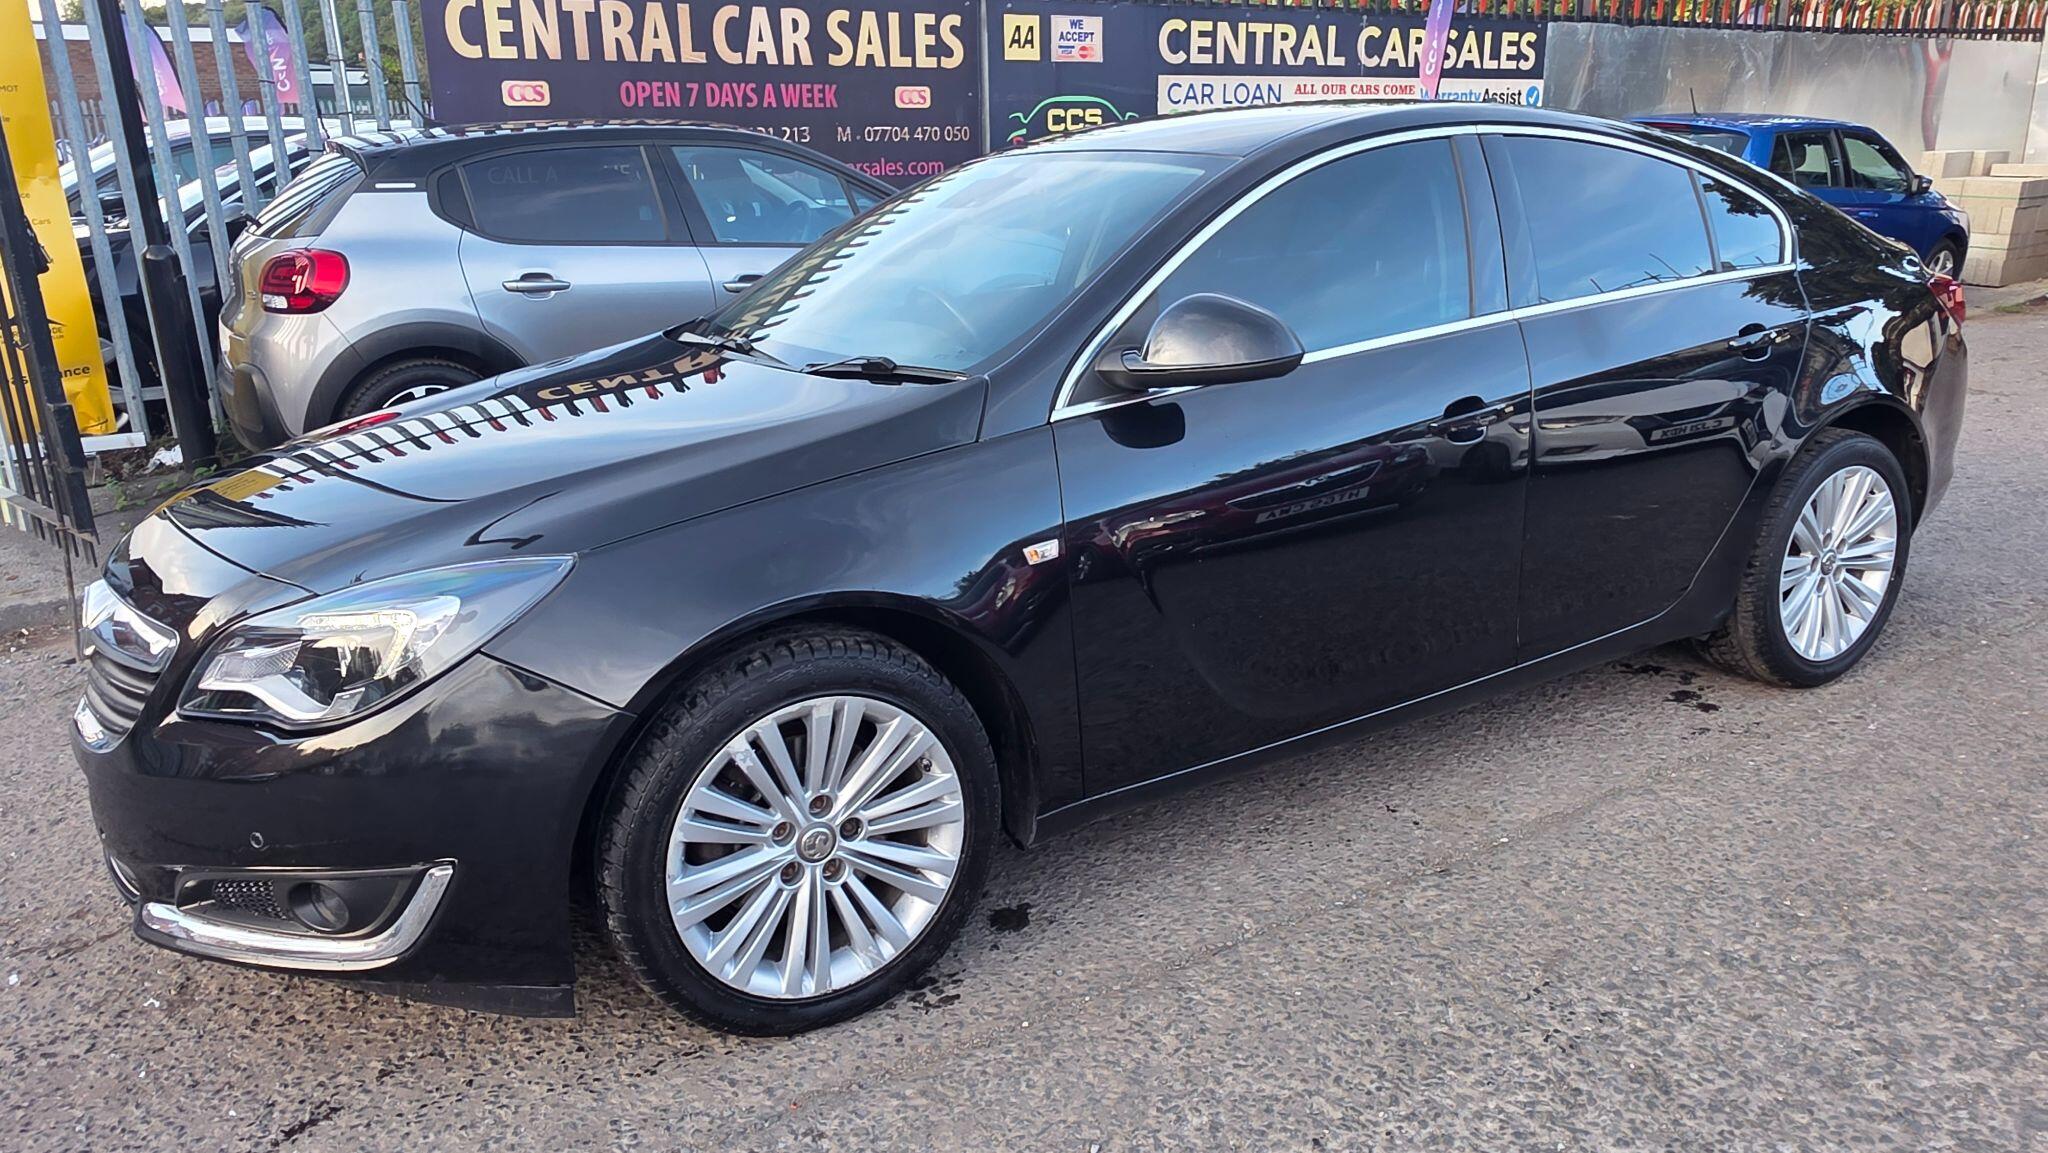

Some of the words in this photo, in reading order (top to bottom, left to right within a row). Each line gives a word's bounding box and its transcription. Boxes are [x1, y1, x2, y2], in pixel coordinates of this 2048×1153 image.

[1069, 19, 1084, 30] WE
[444, 0, 708, 63] CENTRAL
[712, 4, 814, 66] CAR
[826, 9, 965, 69] SALES
[1008, 25, 1035, 49] AA
[1058, 31, 1095, 43] ACCEPT
[1158, 18, 1346, 67] CENTRAL
[1356, 25, 1425, 68] CAR
[1443, 29, 1538, 71] SALES
[507, 84, 545, 103] CCS
[619, 81, 681, 108] OPEN
[686, 82, 699, 108] 7
[705, 82, 758, 108] DAYS
[763, 83, 777, 108] A
[780, 83, 838, 109] WEEK
[898, 89, 927, 105] CCS
[1167, 82, 1215, 105] CAR
[1223, 82, 1282, 105] LOAN
[1294, 84, 1317, 95] ALL
[1321, 84, 1347, 95] OUR
[1350, 84, 1380, 95] CARS
[1383, 84, 1416, 95] COME
[1047, 108, 1103, 132] CCS
[781, 126, 811, 142] 213
[837, 127, 852, 142] M
[864, 127, 910, 142] 07704
[914, 127, 940, 142] 470
[944, 127, 970, 142] 050
